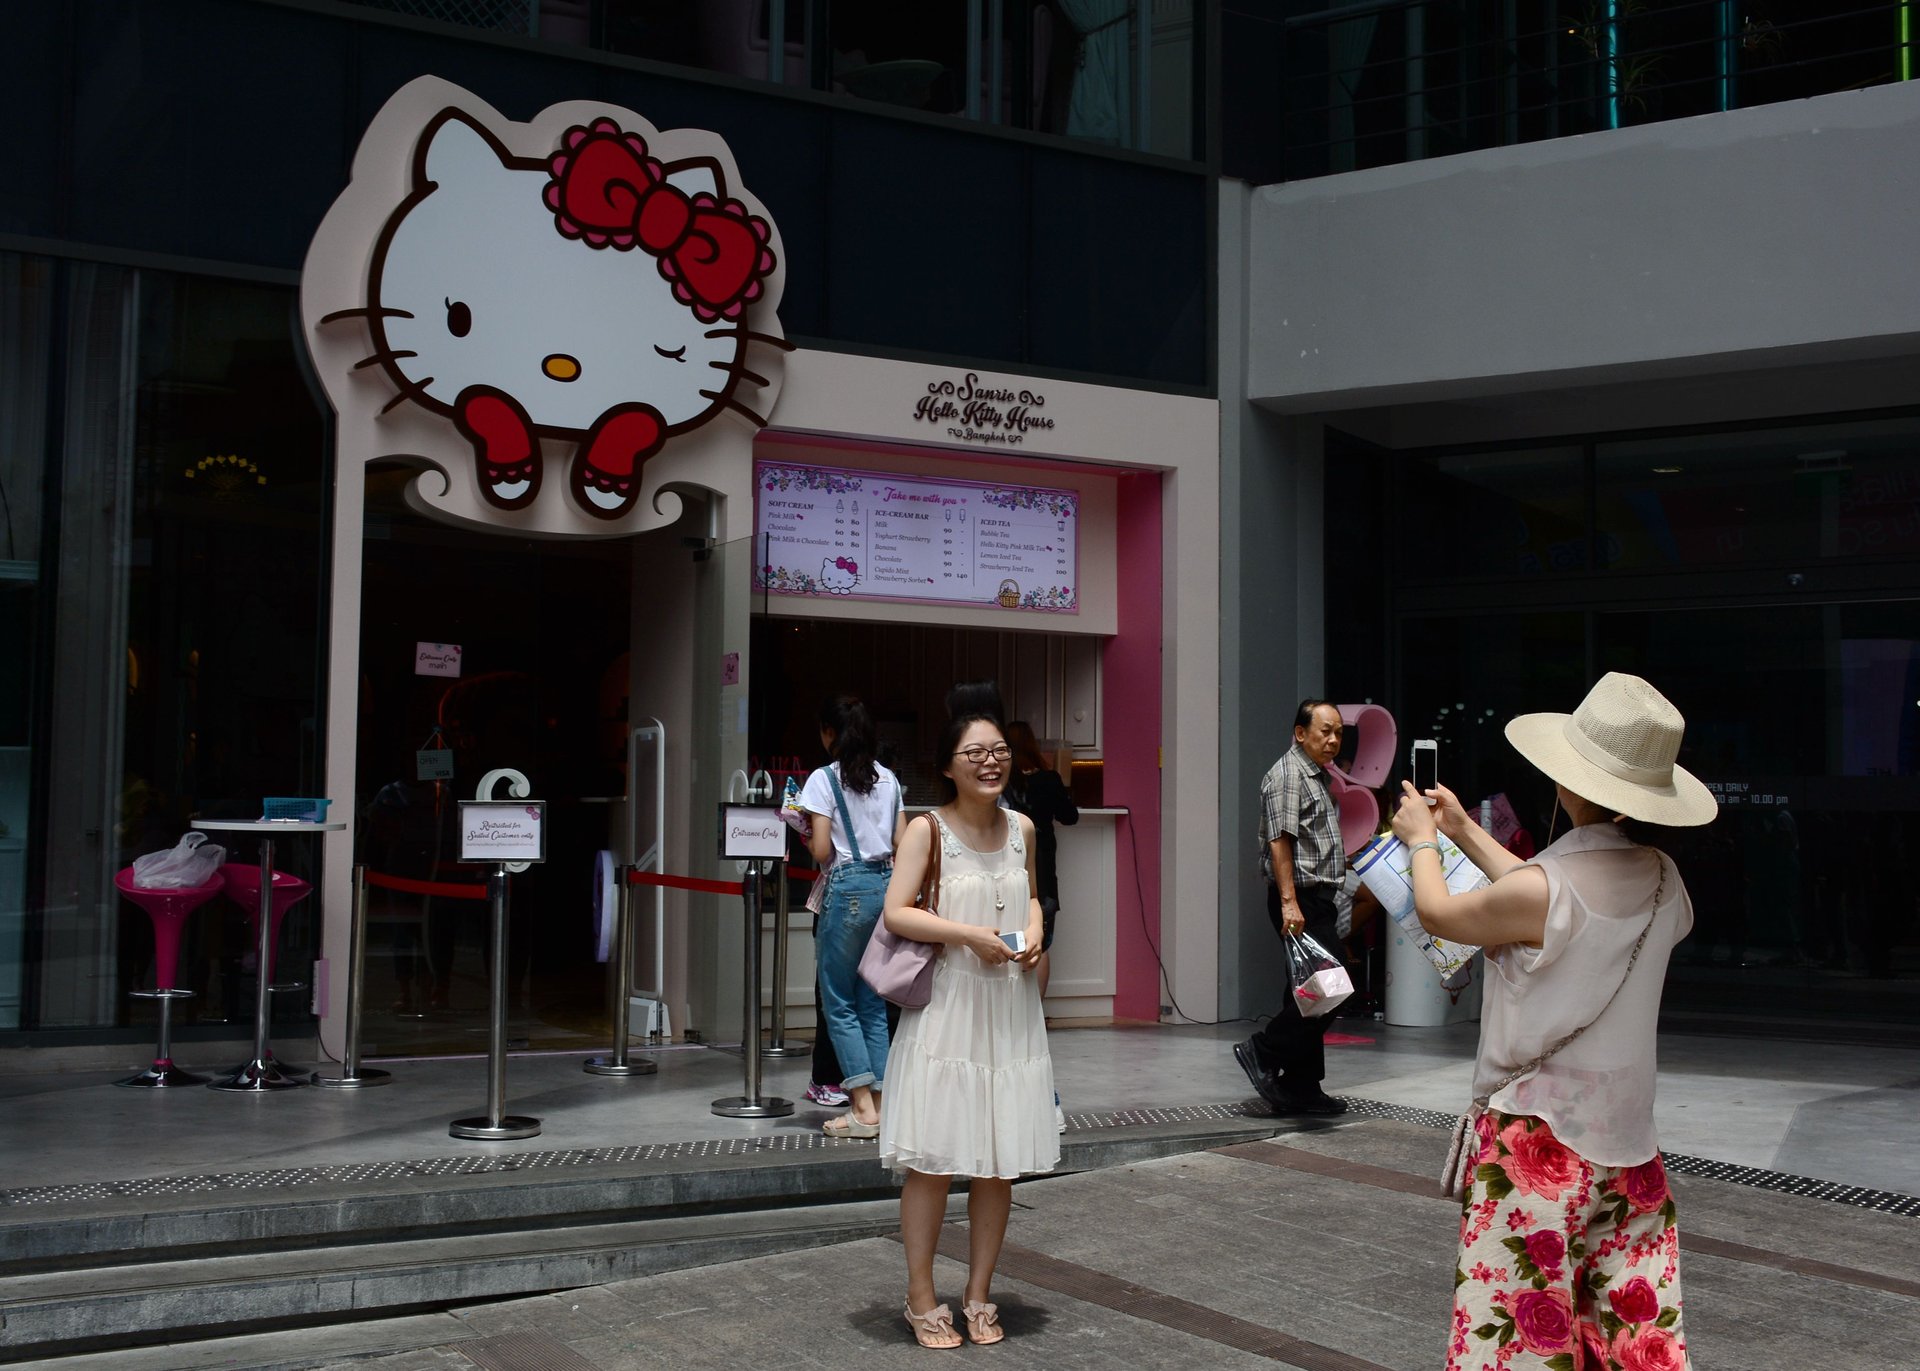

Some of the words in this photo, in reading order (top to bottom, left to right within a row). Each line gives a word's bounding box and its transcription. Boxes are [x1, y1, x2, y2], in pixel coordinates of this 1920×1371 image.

[958, 373, 1016, 403] Sanrio
[913, 395, 959, 423] Hello
[961, 400, 1003, 427] Kitty
[1004, 406, 1054, 432] House
[963, 427, 1006, 444] Bangkok
[883, 487, 906, 502] Take
[923, 494, 940, 503] with
[942, 498, 957, 506] you
[768, 500, 787, 508] SOFT
[788, 502, 813, 510] CREAM
[875, 510, 913, 519] ICE-CREAM
[802, 537, 829, 545] Chocolate
[875, 532, 897, 540] Yoghurt
[899, 534, 931, 544] Strawberry
[996, 542, 1009, 550] Kitty
[980, 563, 1011, 572] Strawberry
[874, 575, 907, 583] Strawberry
[1704, 783, 1723, 792] PEN
[1726, 783, 1749, 792] DAILY
[1728, 796, 1740, 804] am
[1751, 794, 1773, 804] 10.00
[1776, 796, 1788, 805] pm
[480, 821, 512, 831] Restricted
[467, 831, 490, 841] Seated
[491, 831, 519, 840] Customer
[731, 827, 760, 839] Entrance
[762, 827, 778, 839] Only
